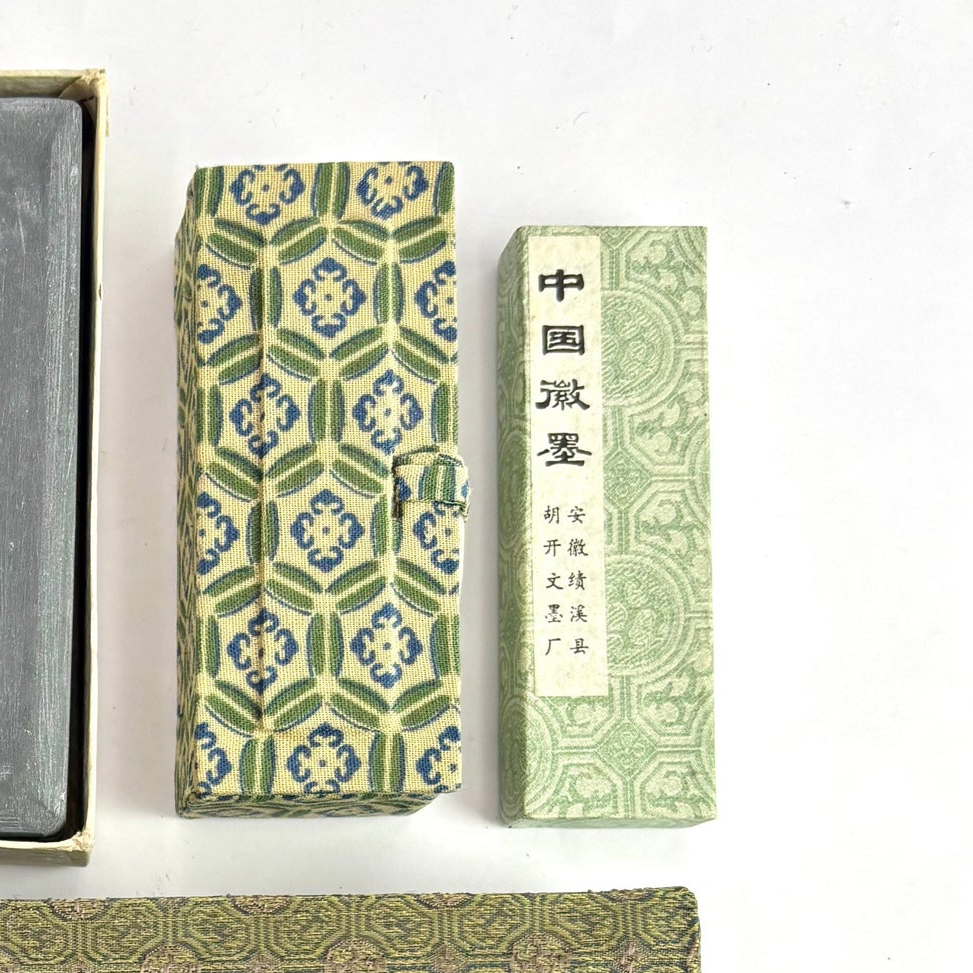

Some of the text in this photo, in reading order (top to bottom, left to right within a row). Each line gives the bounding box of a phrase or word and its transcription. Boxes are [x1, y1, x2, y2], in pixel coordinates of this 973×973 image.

[535, 269, 593, 467] 中国徽墨
[543, 505, 564, 656] 胡开文墨厂
[567, 505, 589, 654] 安徽绩溪县
